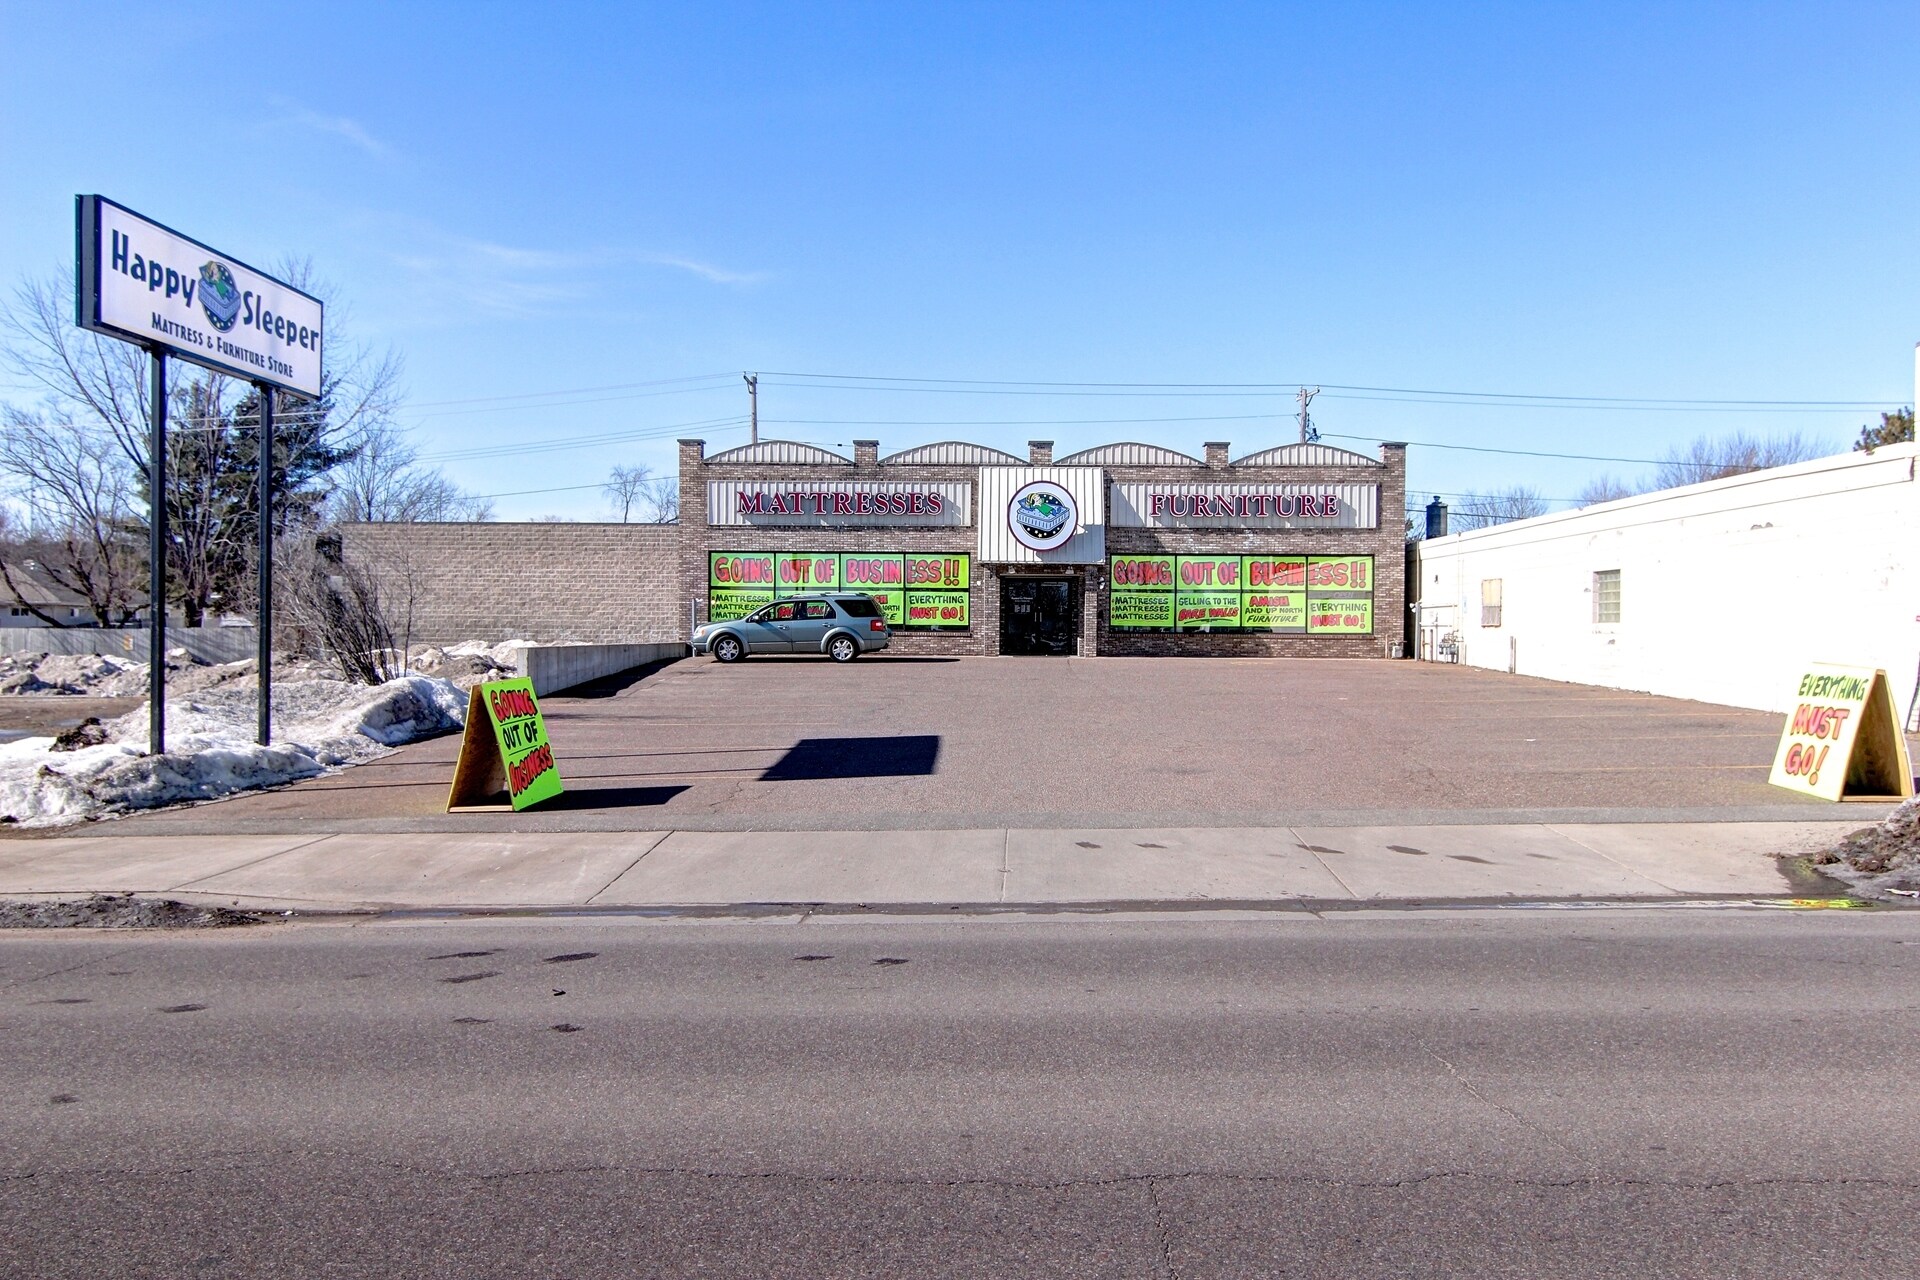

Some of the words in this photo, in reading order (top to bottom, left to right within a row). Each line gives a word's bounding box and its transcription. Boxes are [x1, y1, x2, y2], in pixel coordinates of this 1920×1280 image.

[112, 229, 197, 308] Happy
[243, 290, 320, 352] Sleeper
[151, 311, 204, 347] MATTRESS
[206, 335, 214, 350] &
[217, 336, 266, 369] FURNITURE
[268, 355, 294, 378] STORE
[736, 490, 943, 516] MATTRESSES
[1149, 492, 1340, 518] FURNITURE
[714, 557, 774, 584] GOING
[780, 559, 812, 584] OUT
[814, 559, 835, 584] OF
[1113, 560, 1173, 585] GOING
[1181, 560, 1216, 585] OUT
[1217, 561, 1239, 585] OF
[715, 593, 770, 603] MATTRESSES
[908, 595, 965, 604] EVERYTHING
[1114, 596, 1169, 606] MATTRESSES
[1114, 605, 1170, 613] MATTRESSES
[1178, 597, 1211, 606] SELLING
[1213, 597, 1222, 605] TO
[1223, 597, 1237, 606] THE
[1249, 595, 1290, 607] AMISH
[1310, 603, 1368, 612] EVERYTHING
[909, 606, 940, 620] MUST
[941, 606, 966, 622] GO!
[1114, 612, 1169, 620] MATTRESSES
[1247, 615, 1299, 623] FURNITURE
[1311, 614, 1343, 628] MUST
[1344, 613, 1366, 629] GO!
[1798, 673, 1870, 701] EVERYTHING
[490, 687, 539, 724] GOING
[1790, 703, 1851, 741] MUST
[502, 723, 523, 750] OUT
[523, 720, 539, 743] OF
[508, 742, 554, 798] BUSINESS
[1784, 742, 1831, 786] GO!
